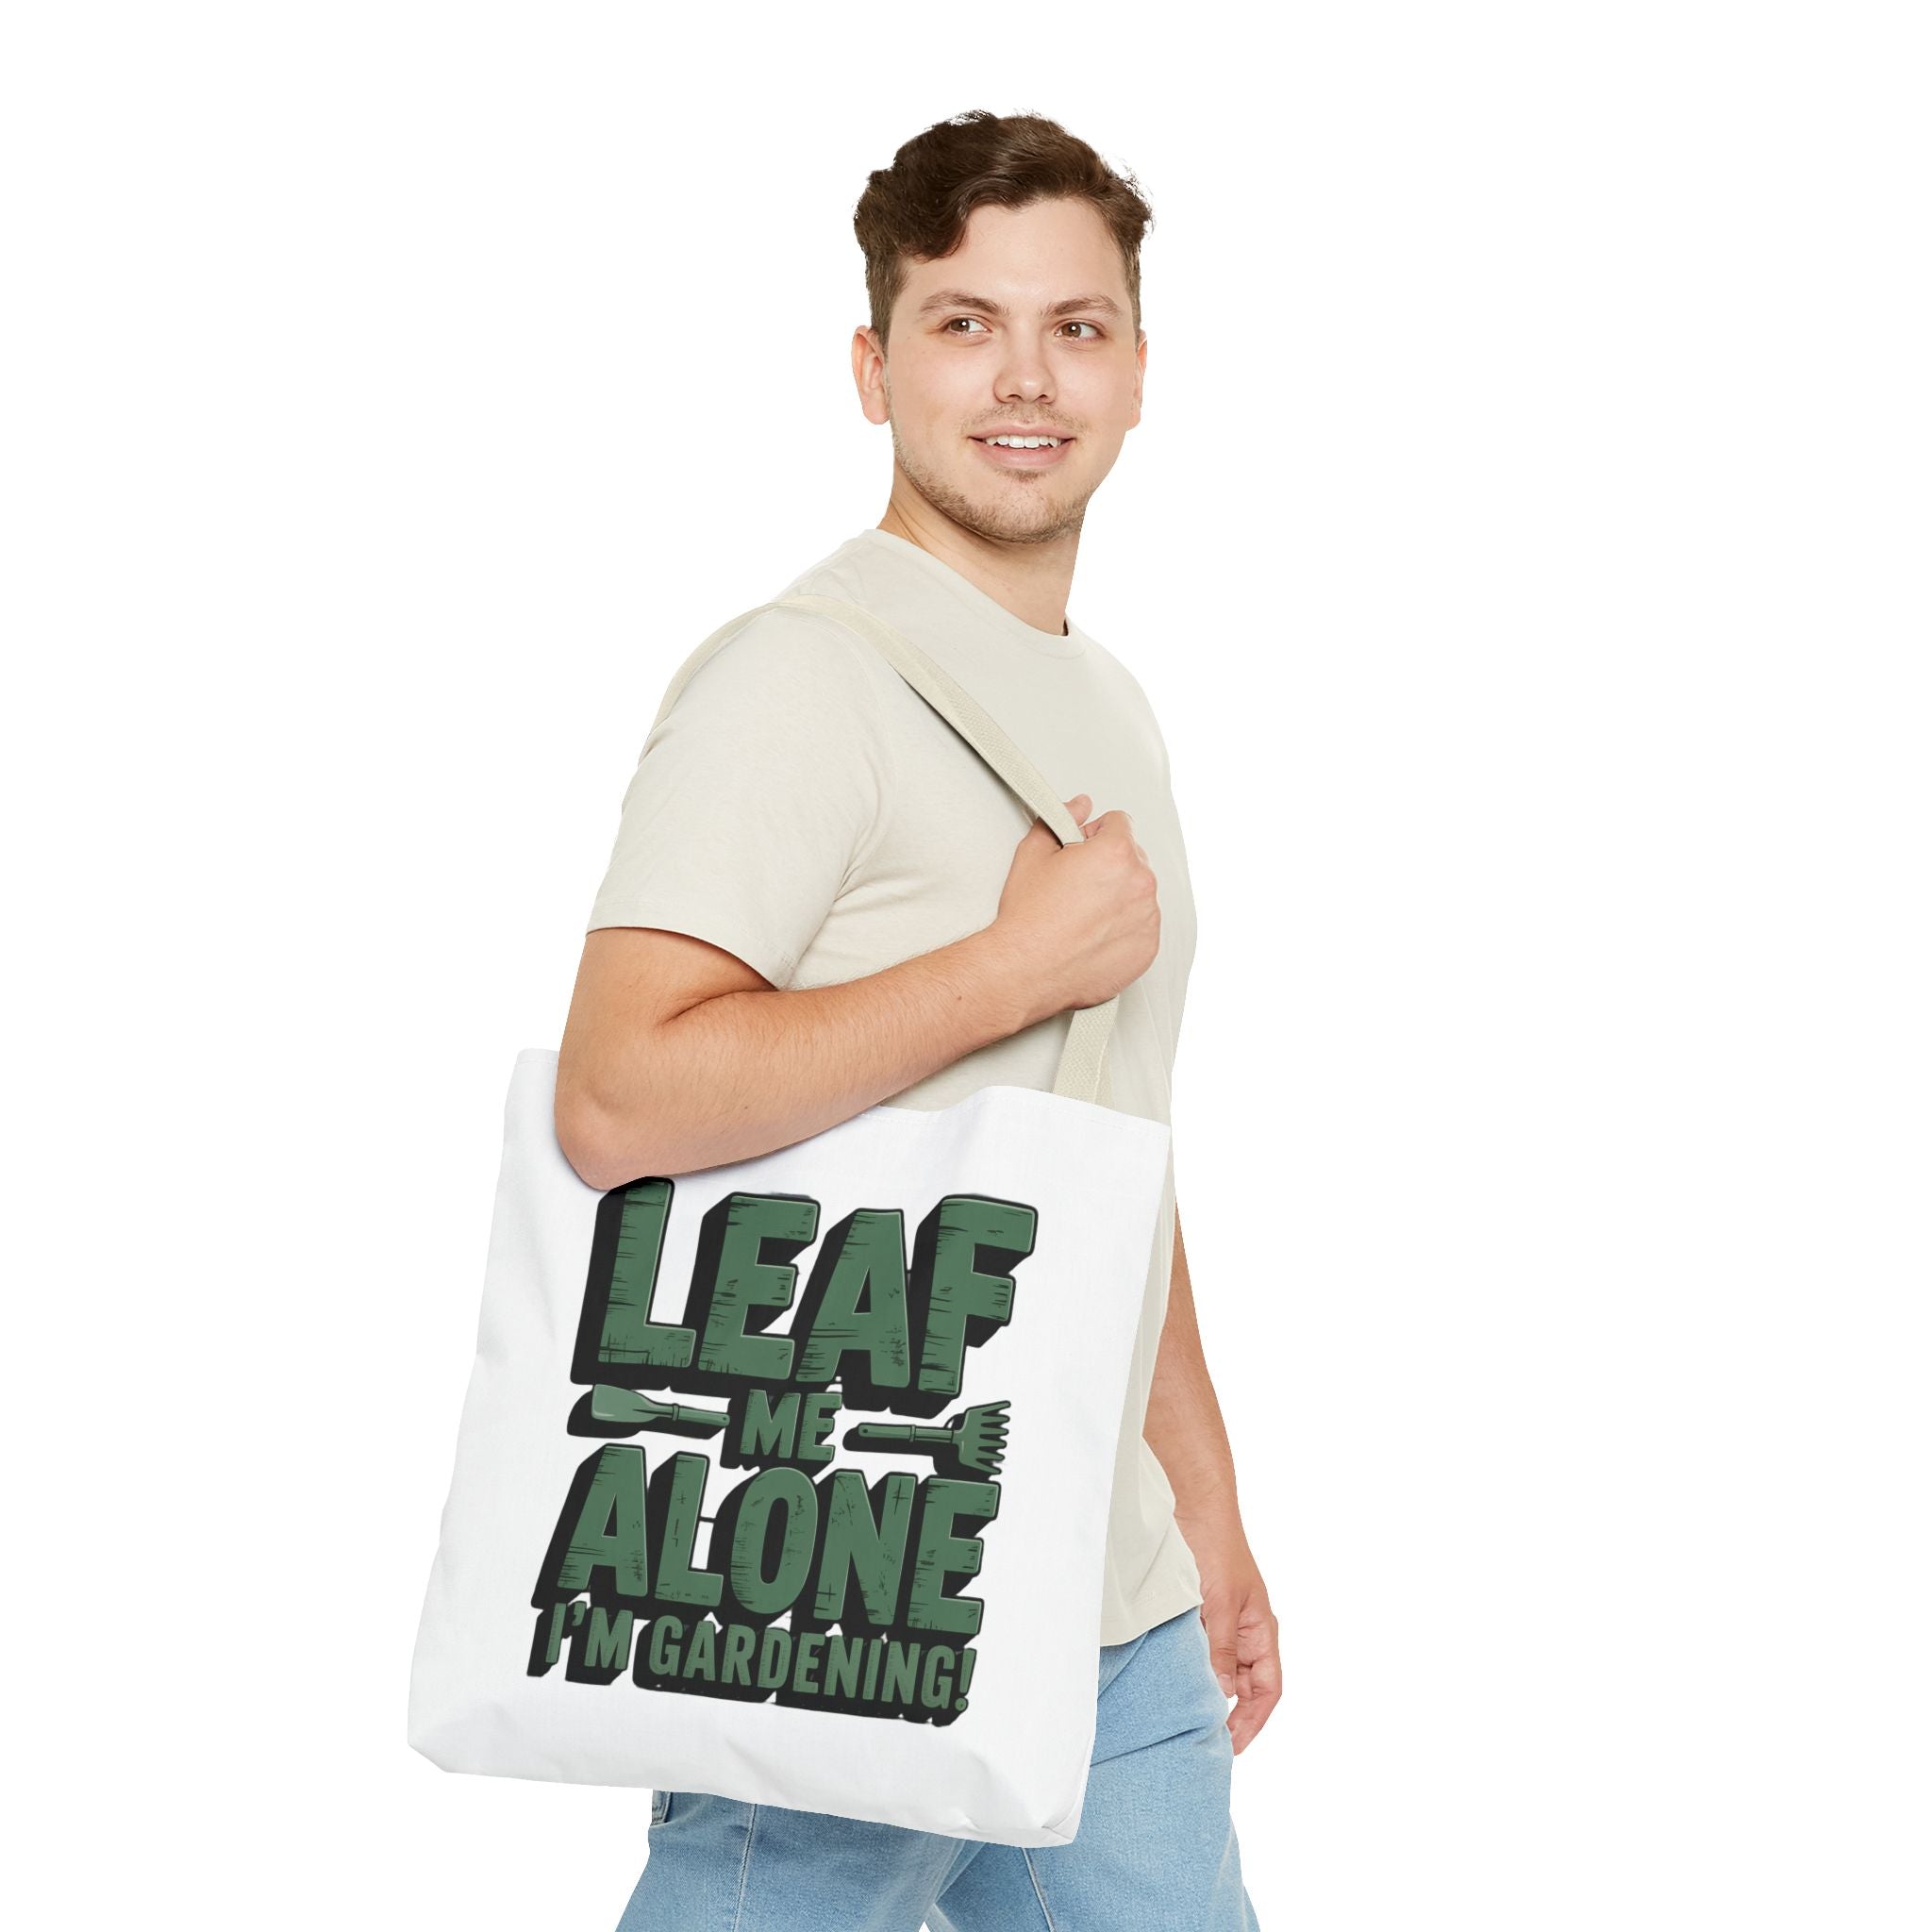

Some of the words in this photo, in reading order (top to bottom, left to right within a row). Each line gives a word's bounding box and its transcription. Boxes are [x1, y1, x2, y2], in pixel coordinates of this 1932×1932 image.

[592, 1176, 1038, 1398] LEAF
[736, 1389, 842, 1462] ME
[553, 1443, 1001, 1636] ALONE
[541, 1601, 635, 1674] I'M
[645, 1614, 977, 1712] GARDENING!
